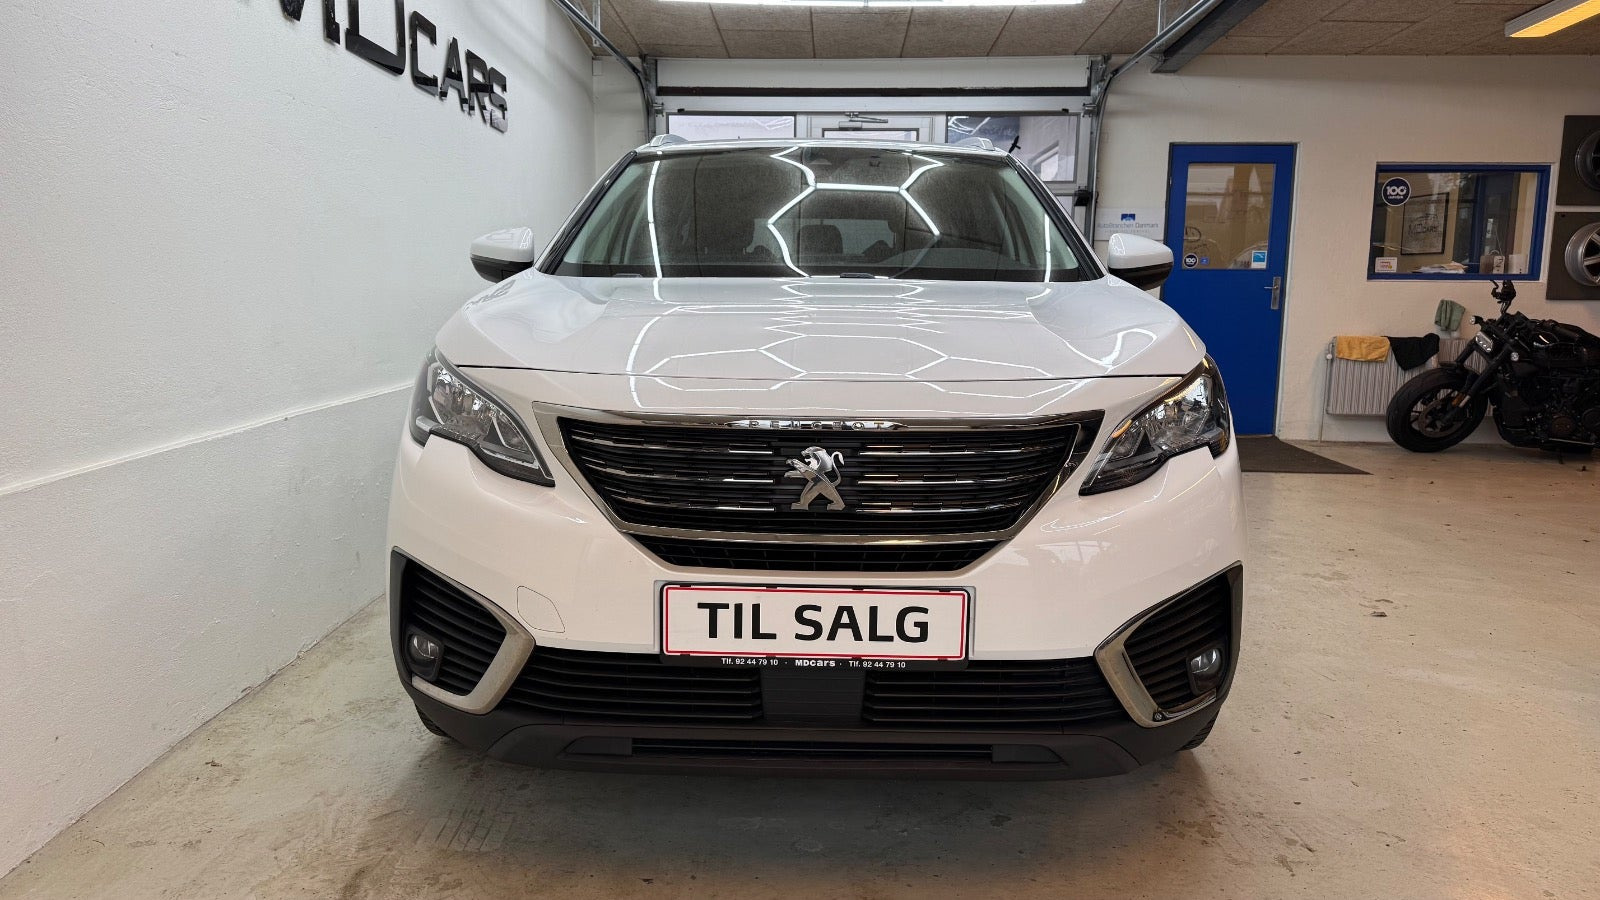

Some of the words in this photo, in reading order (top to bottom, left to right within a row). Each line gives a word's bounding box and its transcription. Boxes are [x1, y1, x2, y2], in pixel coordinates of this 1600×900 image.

[749, 420, 885, 430] PEUGEOT
[697, 602, 777, 640] TIL
[794, 604, 929, 643] SALG
[721, 657, 734, 665] Tlf.
[795, 659, 836, 667] MDcars
[848, 660, 861, 668] Tlf.
[862, 660, 873, 668] 92
[896, 661, 906, 669] 10
